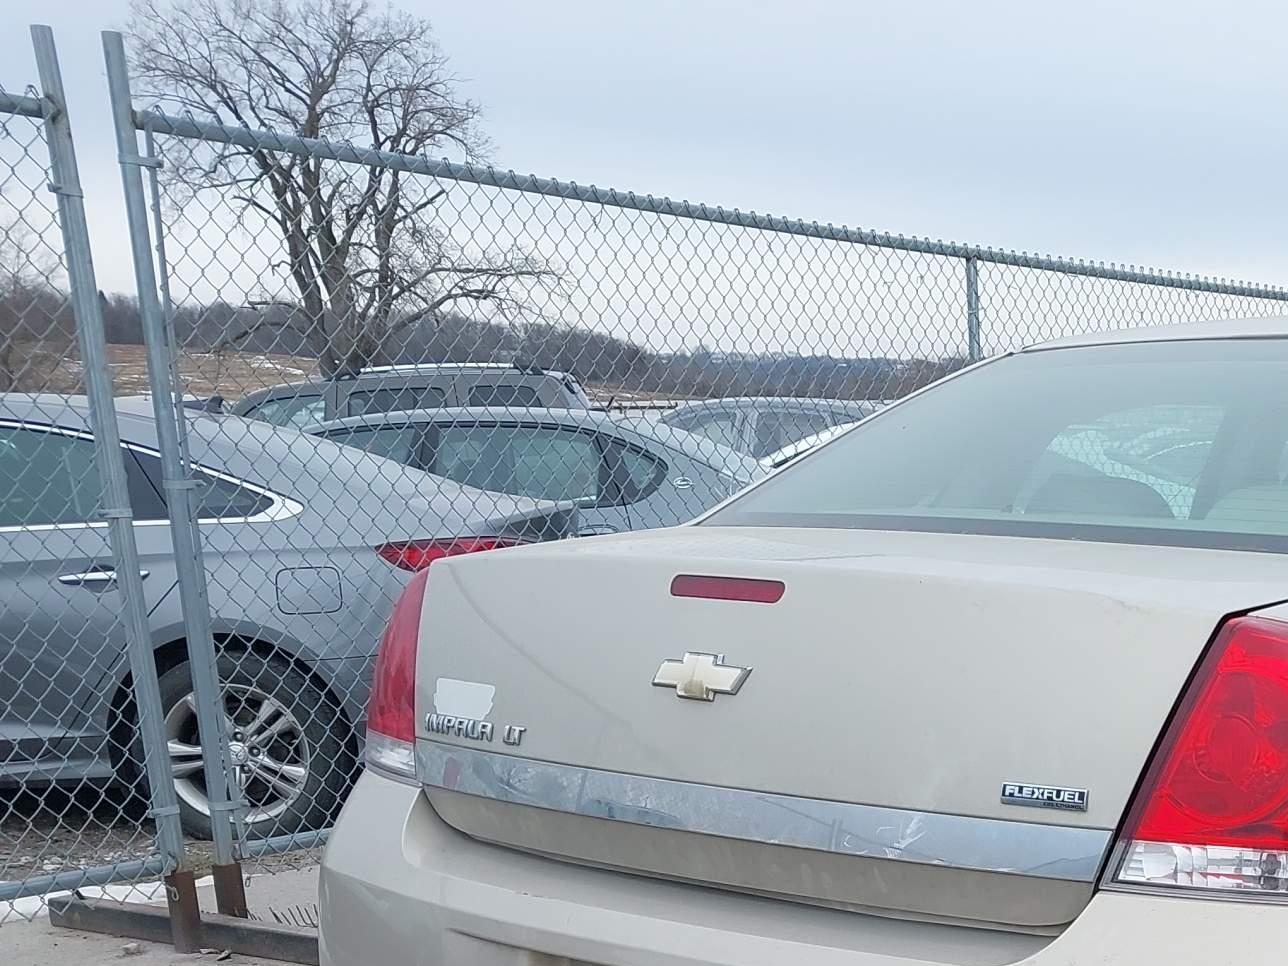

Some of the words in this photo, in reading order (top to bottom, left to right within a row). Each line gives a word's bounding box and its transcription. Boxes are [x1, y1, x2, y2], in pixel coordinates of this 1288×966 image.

[425, 712, 493, 742] IMPALA
[503, 724, 527, 746] LT
[1004, 785, 1083, 803] FLEXFUEL
